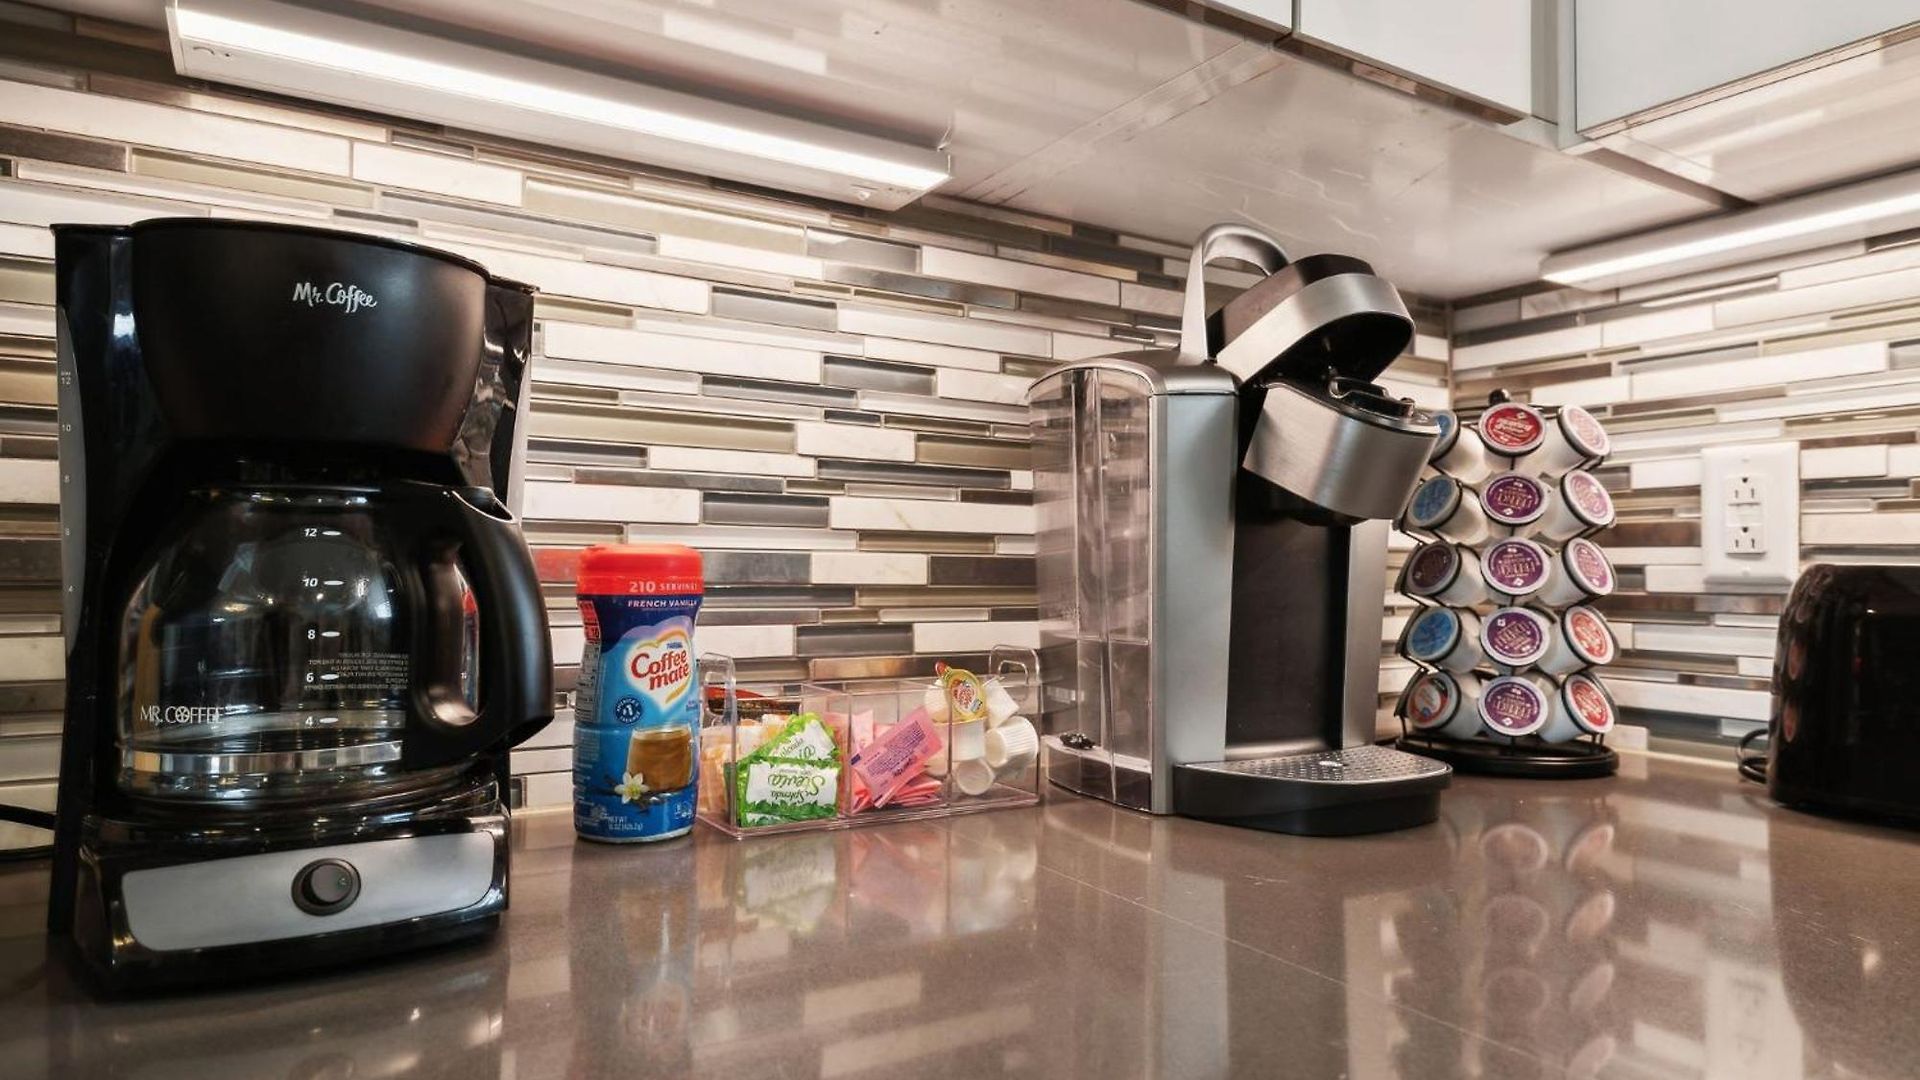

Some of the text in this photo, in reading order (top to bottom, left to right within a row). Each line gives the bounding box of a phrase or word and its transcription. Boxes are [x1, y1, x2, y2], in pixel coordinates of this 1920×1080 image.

[292, 282, 378, 313] Mr. Coffee
[304, 528, 317, 537] 12
[302, 578, 319, 587] 10
[629, 581, 656, 593] 210
[627, 599, 667, 608] FRENCH
[307, 629, 316, 640] 8
[630, 650, 687, 678] Coffee
[306, 672, 315, 682] 6
[648, 663, 689, 691] mate
[140, 705, 164, 723] MR.
[305, 716, 313, 726] 4
[767, 774, 826, 796] Stevia
[770, 790, 807, 804] Splenda
